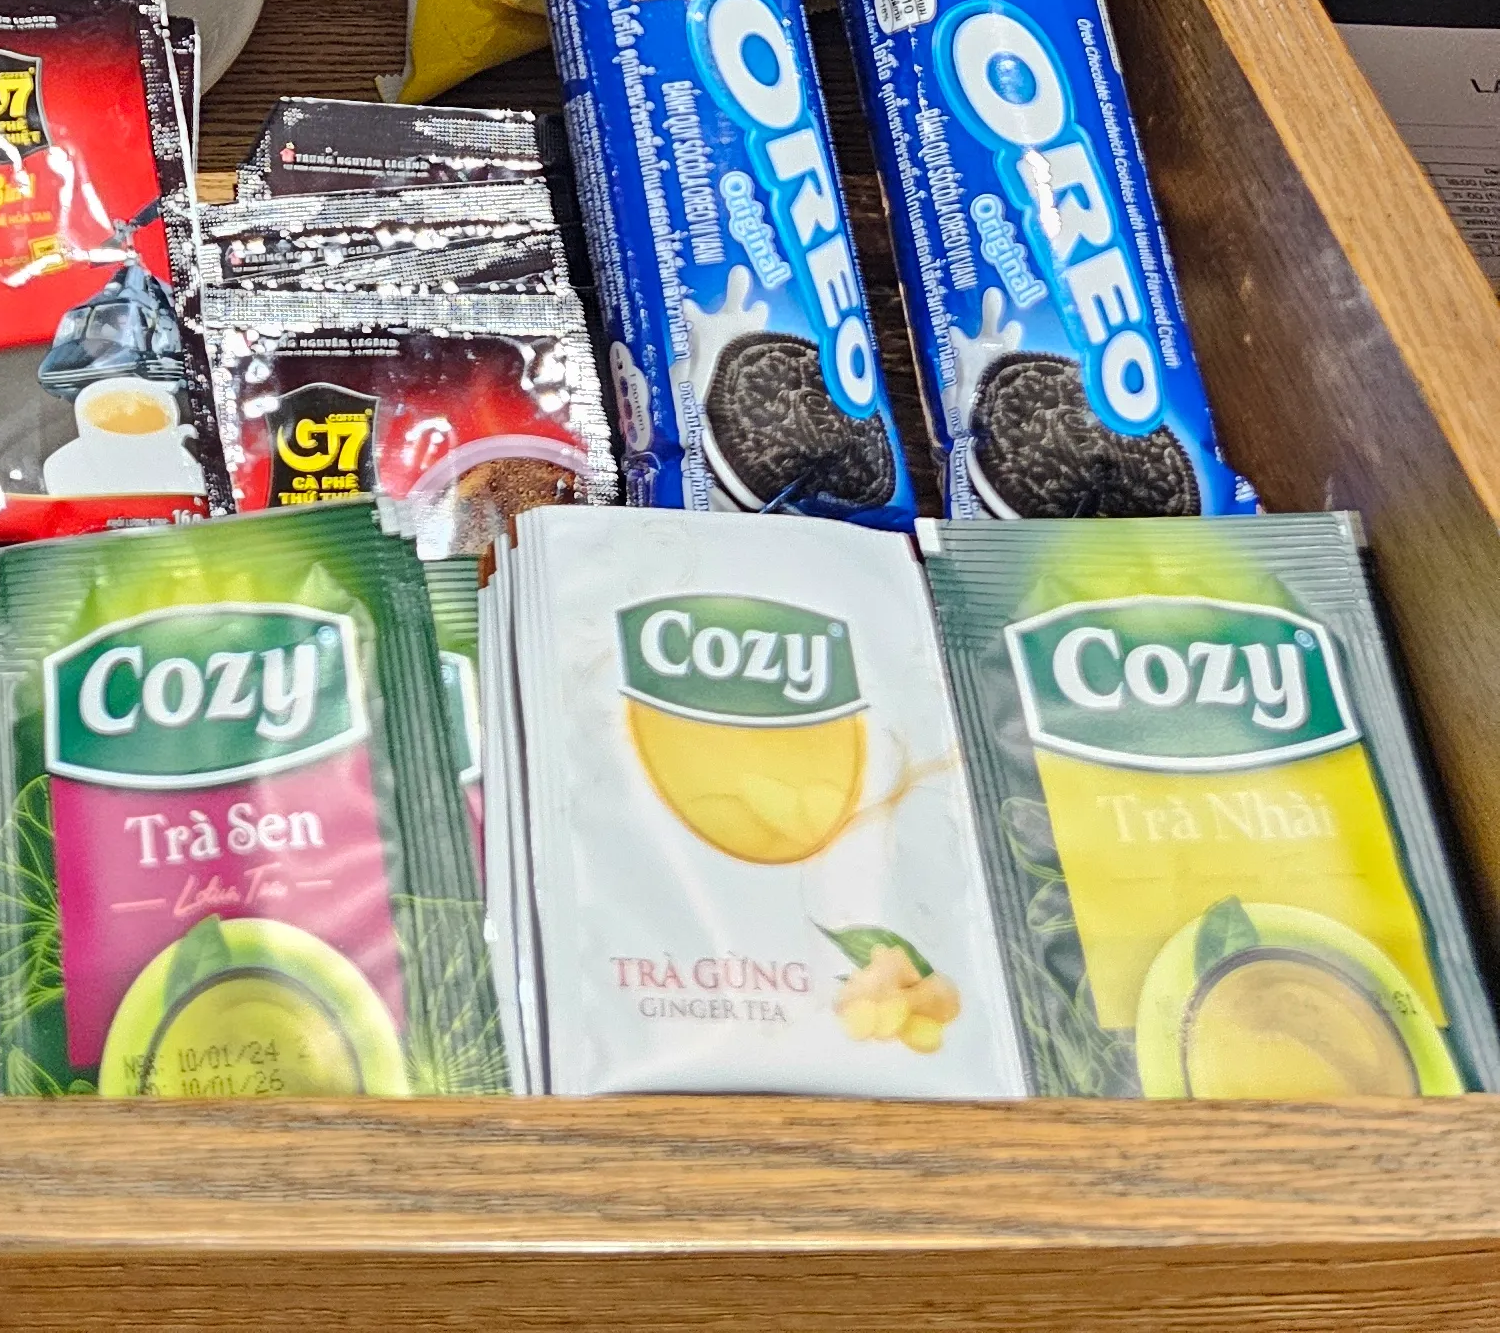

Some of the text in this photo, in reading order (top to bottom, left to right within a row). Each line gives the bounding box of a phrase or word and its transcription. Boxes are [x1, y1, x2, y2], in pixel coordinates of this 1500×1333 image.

[296, 154, 333, 164] TRUNG
[385, 160, 430, 170] LEGEND
[682, 187, 718, 221] OREO
[953, 11, 1162, 424] OREO
[1077, 19, 1178, 366] Oreo Chocolate Sandwich Cookies with Vanilla Flavored Cream
[720, 171, 793, 290] Original
[939, 213, 968, 247] OREO
[971, 193, 1048, 310] Original
[351, 338, 400, 348] LEGEND
[628, 381, 649, 432] portion
[277, 419, 370, 472] G7
[292, 473, 359, 490] CÀ PHÊ
[639, 609, 835, 703] Cozy
[1051, 626, 1314, 730] Cozy
[78, 643, 320, 741] Cozy
[125, 804, 325, 866] Trà Sen
[1096, 790, 1337, 843] Trà Nhài
[609, 945, 813, 995] TRÀ GỪNG
[639, 995, 788, 1024] GINGER TEA
[177, 1038, 281, 1073] 10/01/24
